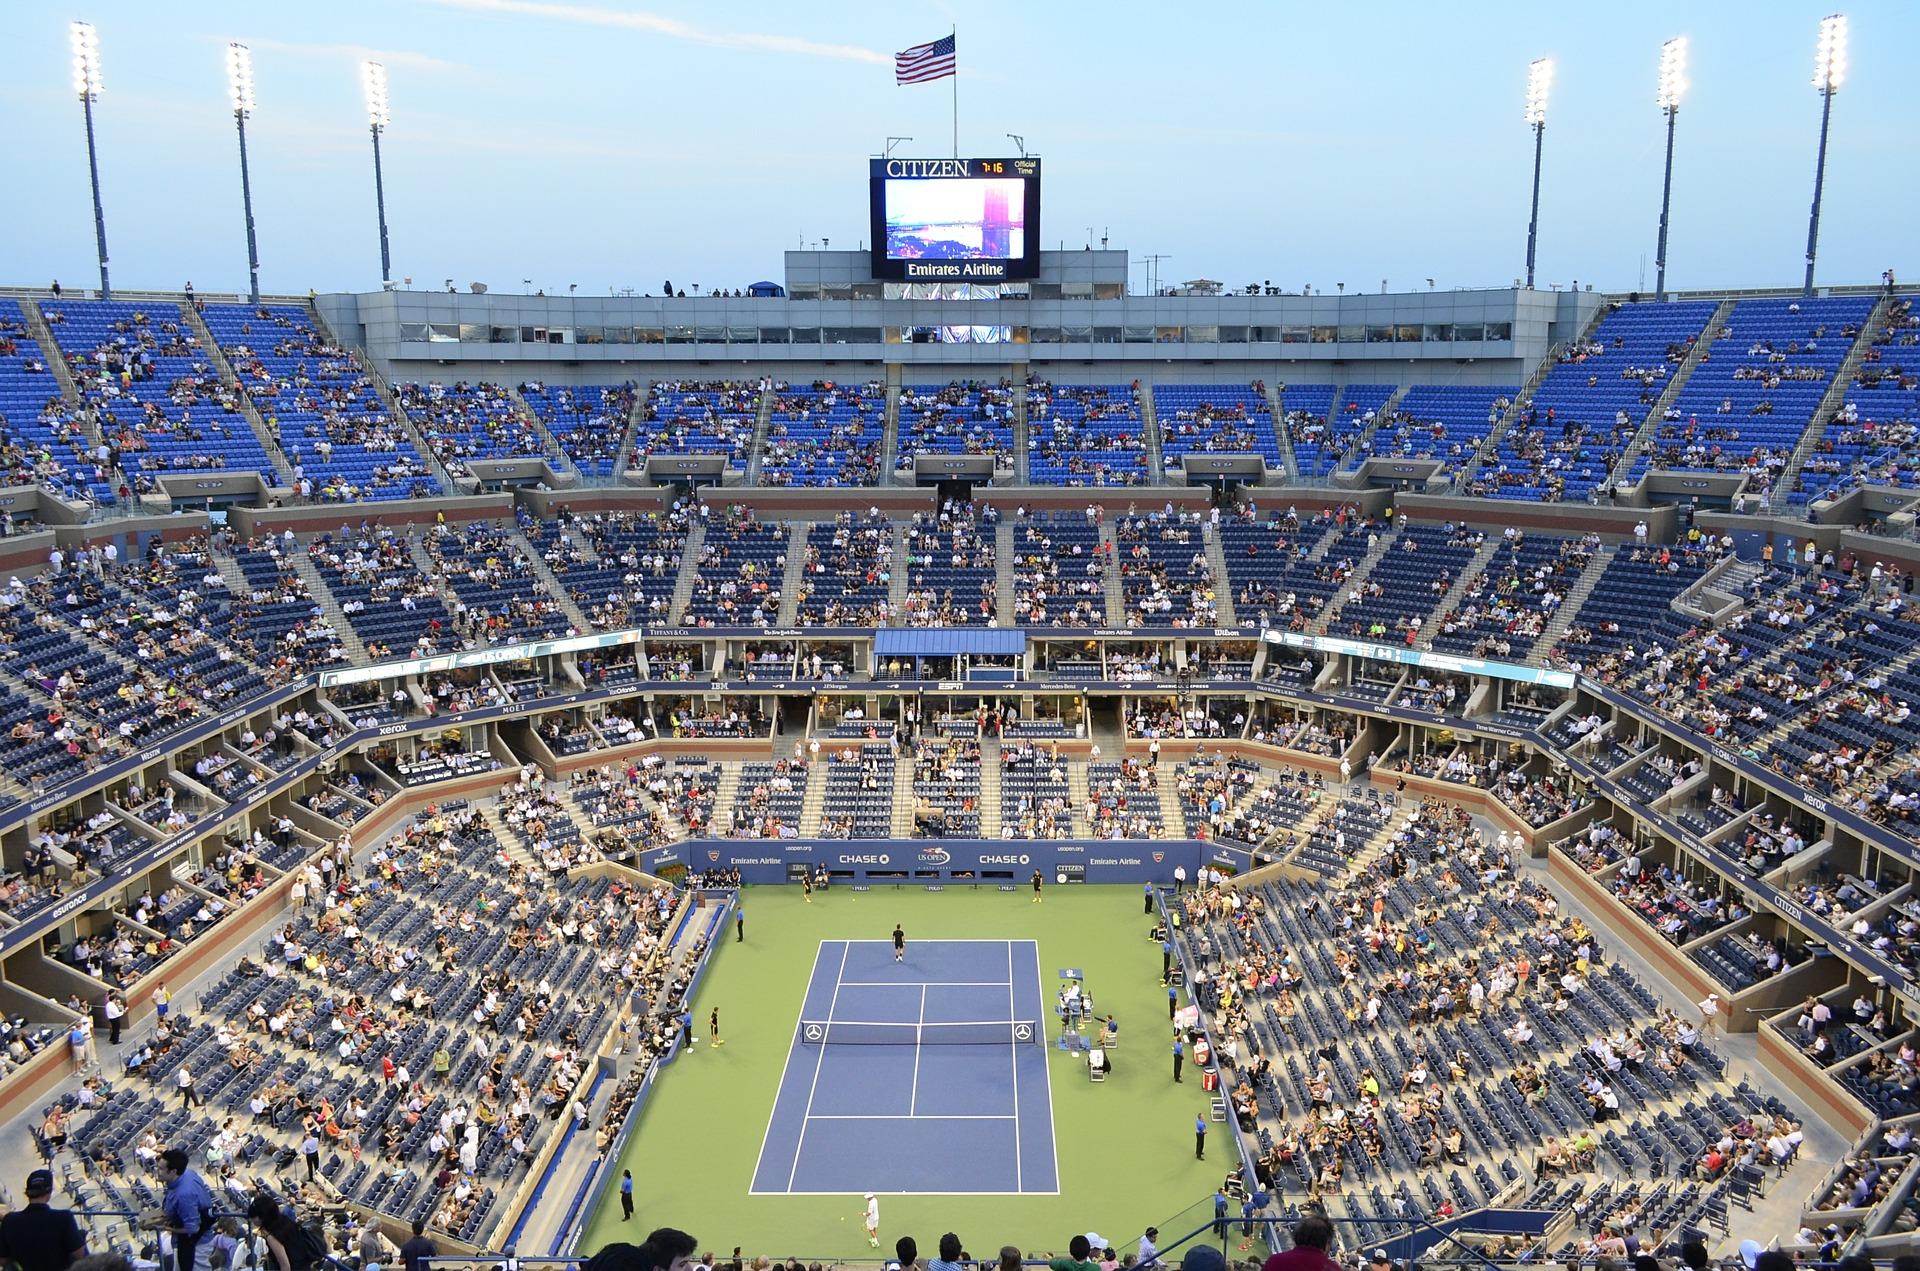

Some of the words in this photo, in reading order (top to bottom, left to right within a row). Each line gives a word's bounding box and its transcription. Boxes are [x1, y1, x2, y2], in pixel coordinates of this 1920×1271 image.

[886, 160, 969, 177] CITIZEN
[982, 162, 1002, 173] 7:16
[908, 264, 960, 276] Emirates
[963, 264, 1004, 276] Airline
[380, 724, 408, 736] xerox
[1802, 793, 1827, 812] xerox
[839, 855, 877, 863] CHASE
[980, 855, 1017, 863] CHASE
[52, 893, 87, 918] esurance
[1774, 896, 1802, 920] CITIZEN
